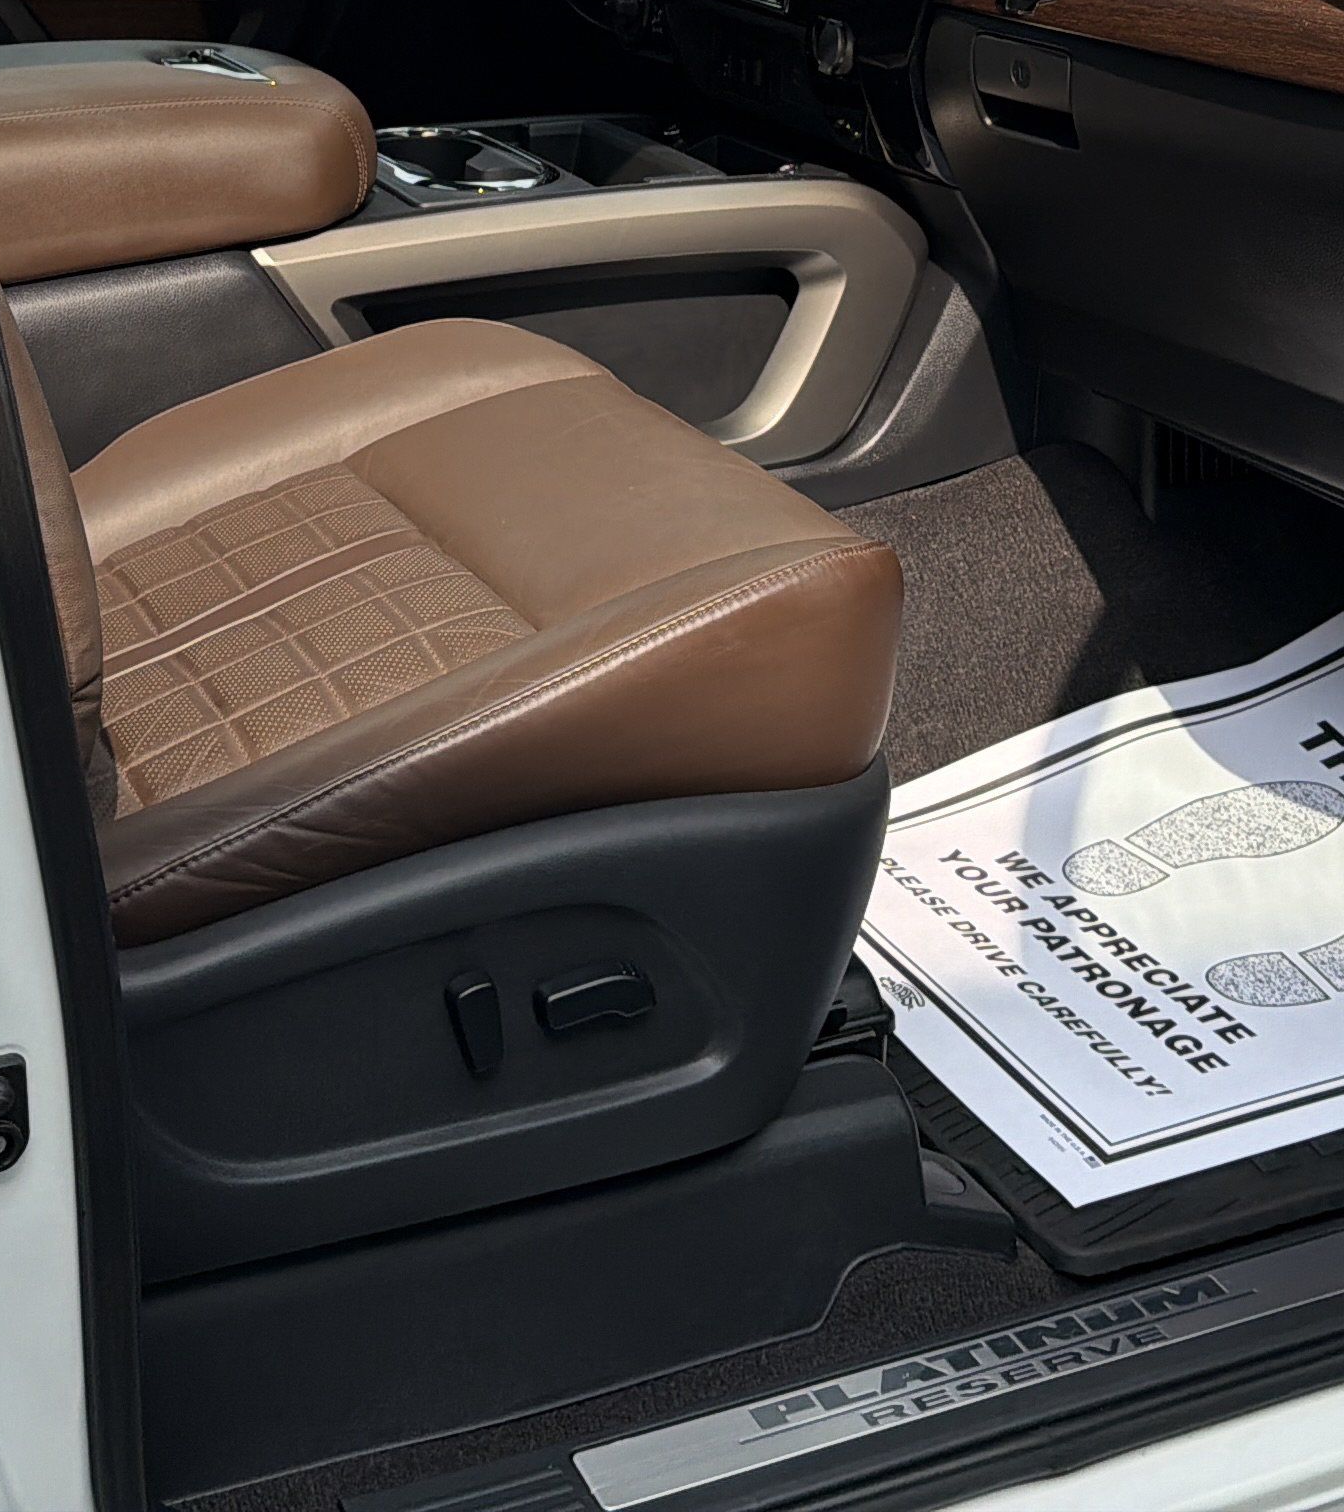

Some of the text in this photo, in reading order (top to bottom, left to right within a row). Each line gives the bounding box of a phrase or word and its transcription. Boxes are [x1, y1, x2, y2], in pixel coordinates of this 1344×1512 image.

[880, 857, 1174, 1097] PLEASE DRIVE CAREFULLY!
[938, 849, 1231, 1074] YOUR PATRONAGE
[994, 850, 1258, 1045] WE APPRECIATE
[748, 1275, 1229, 1430] PLATINUM
[860, 1325, 1167, 1427] RESERVE
